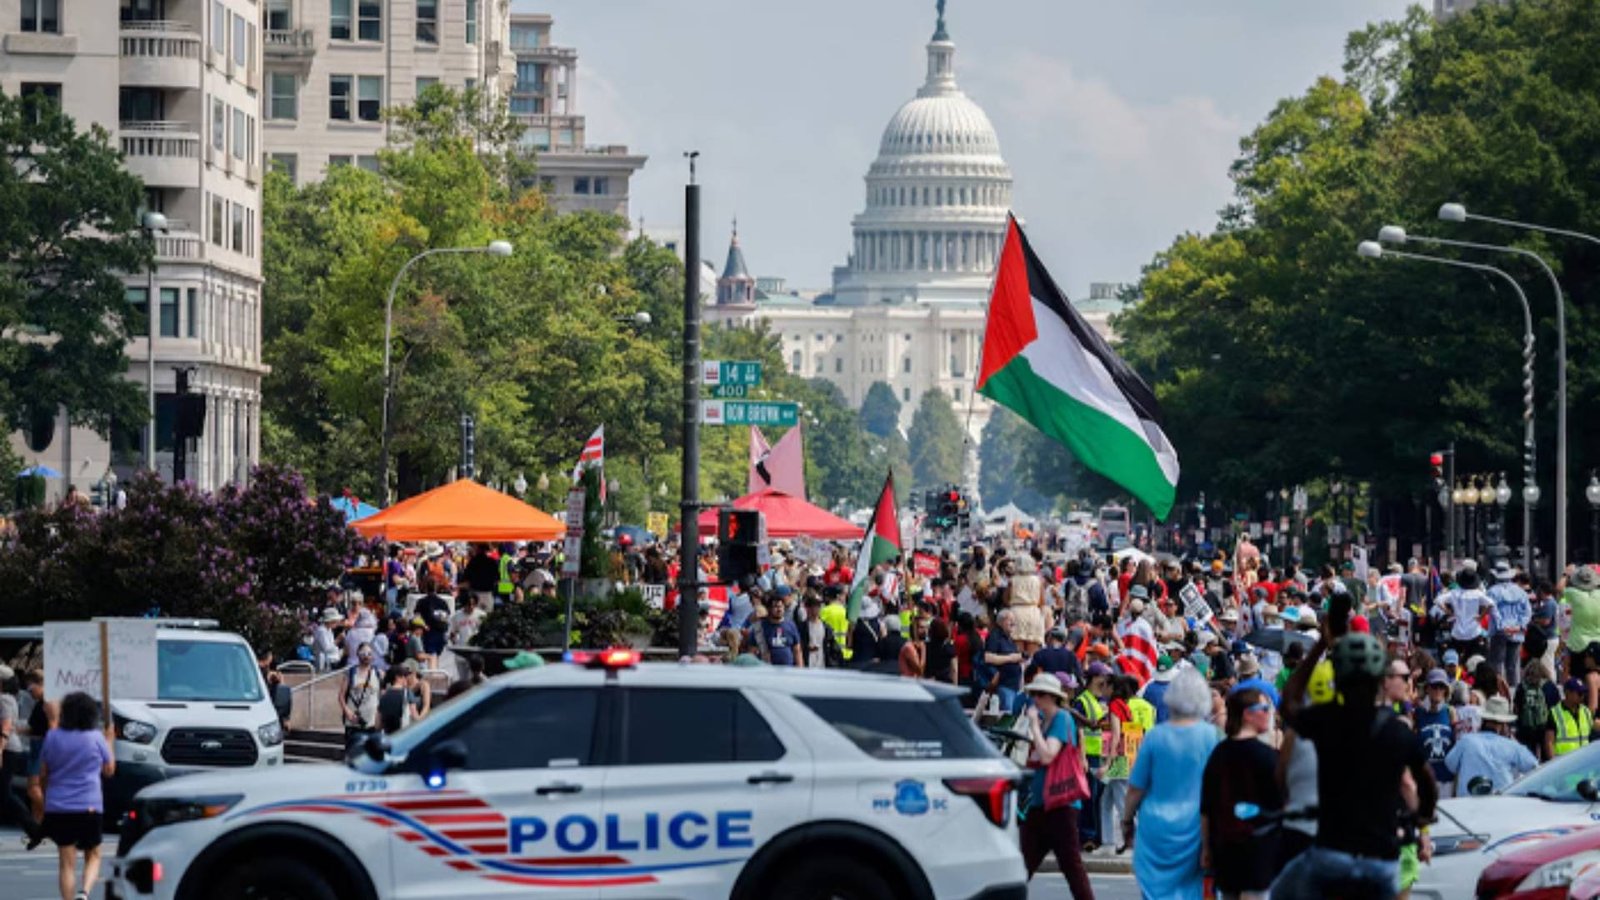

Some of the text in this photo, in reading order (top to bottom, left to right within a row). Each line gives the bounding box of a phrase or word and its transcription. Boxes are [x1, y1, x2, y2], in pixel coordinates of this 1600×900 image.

[726, 364, 738, 382] 14
[717, 385, 744, 396] 400
[510, 811, 754, 854] POLICE
